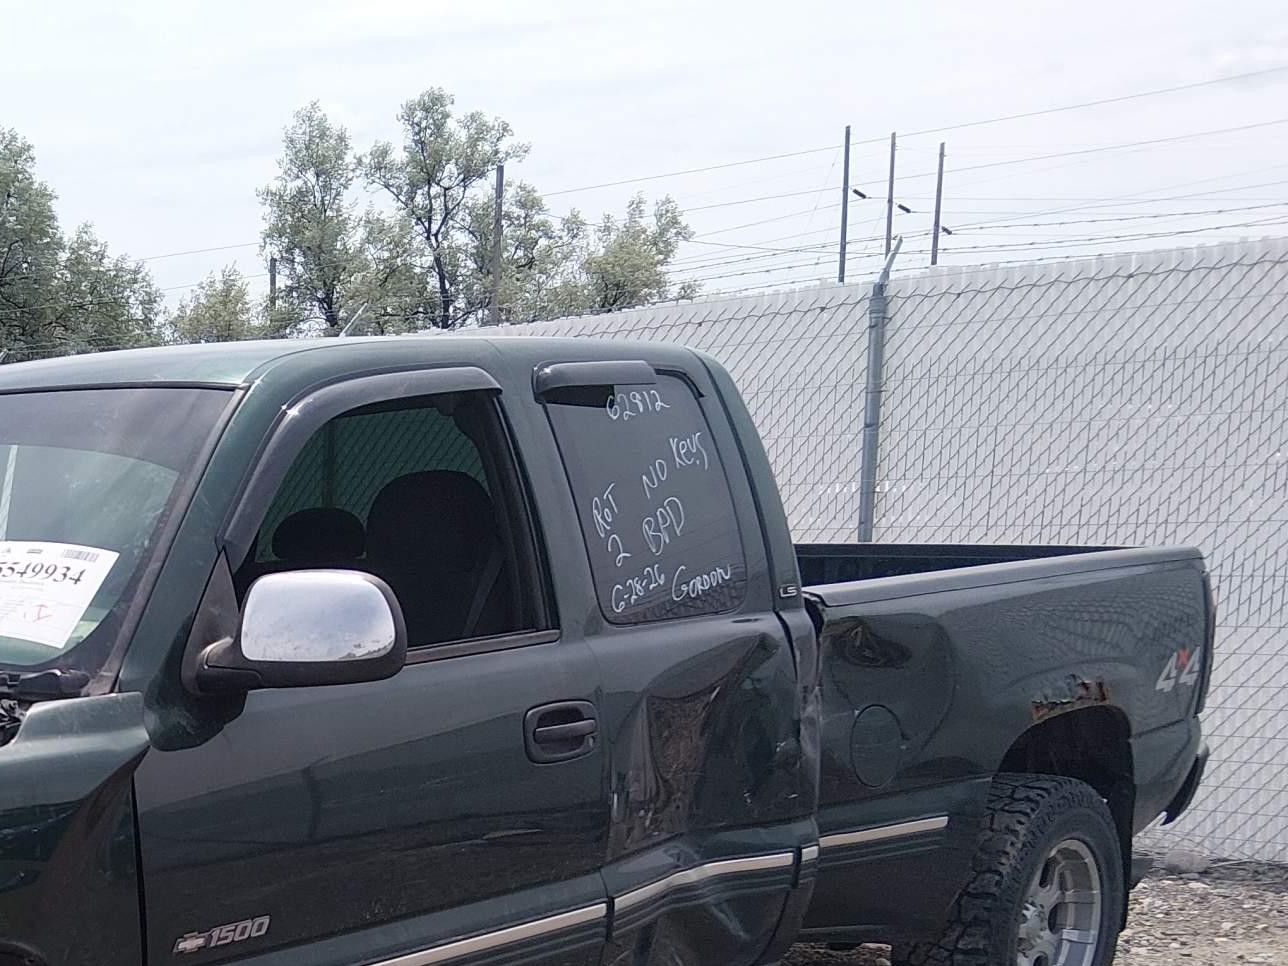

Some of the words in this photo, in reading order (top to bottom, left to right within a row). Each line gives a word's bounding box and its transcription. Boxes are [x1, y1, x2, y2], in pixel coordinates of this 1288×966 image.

[605, 389, 671, 421] 62812
[642, 459, 668, 499] NO
[607, 534, 632, 567] 2
[208, 914, 271, 947] 1500
